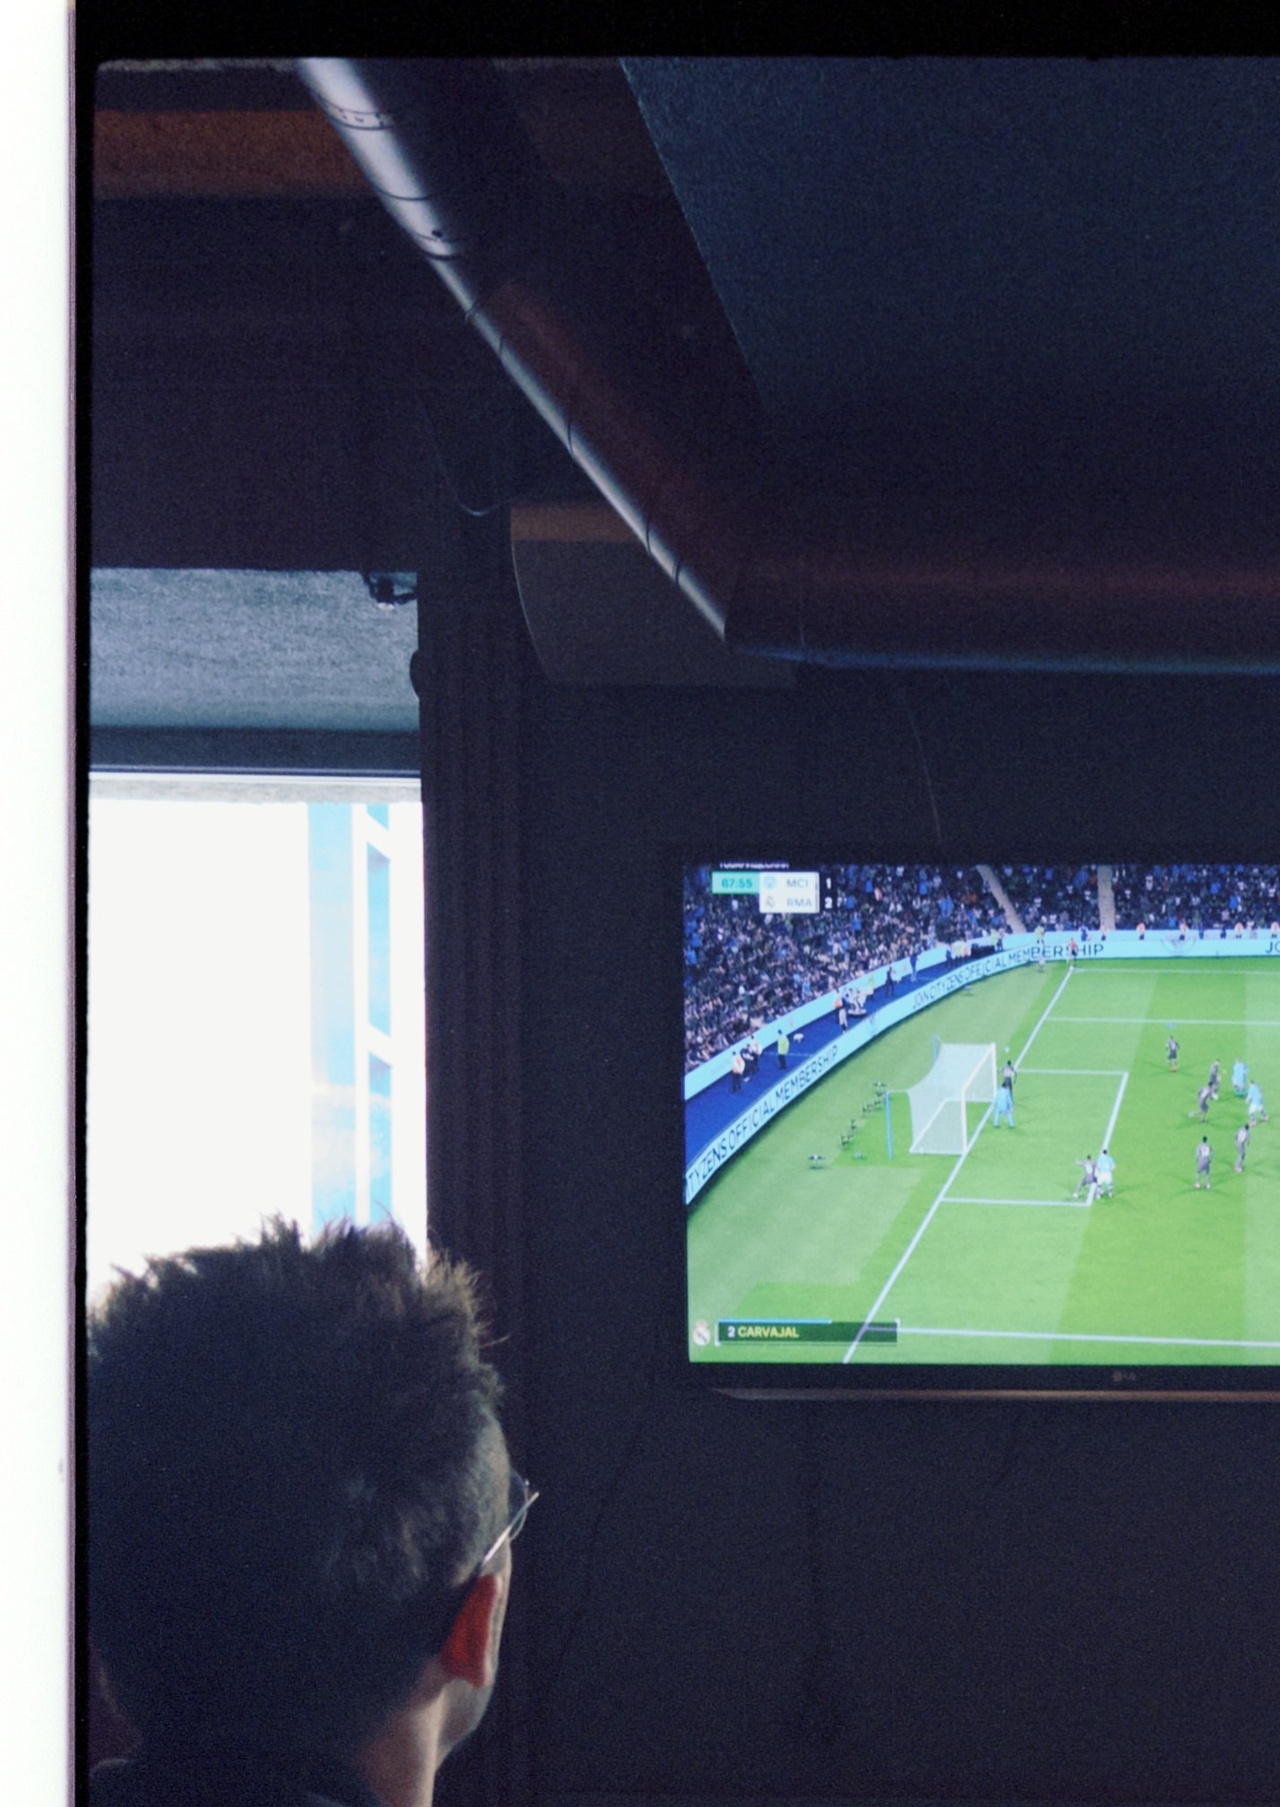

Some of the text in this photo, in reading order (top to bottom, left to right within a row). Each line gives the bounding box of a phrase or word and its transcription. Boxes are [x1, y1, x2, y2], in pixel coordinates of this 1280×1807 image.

[786, 877, 832, 890] MCI 1
[786, 896, 813, 908] RMA
[776, 1045, 838, 1101] MEMBERSHIP
[727, 1326, 800, 1339] 2 CARVAJAL
